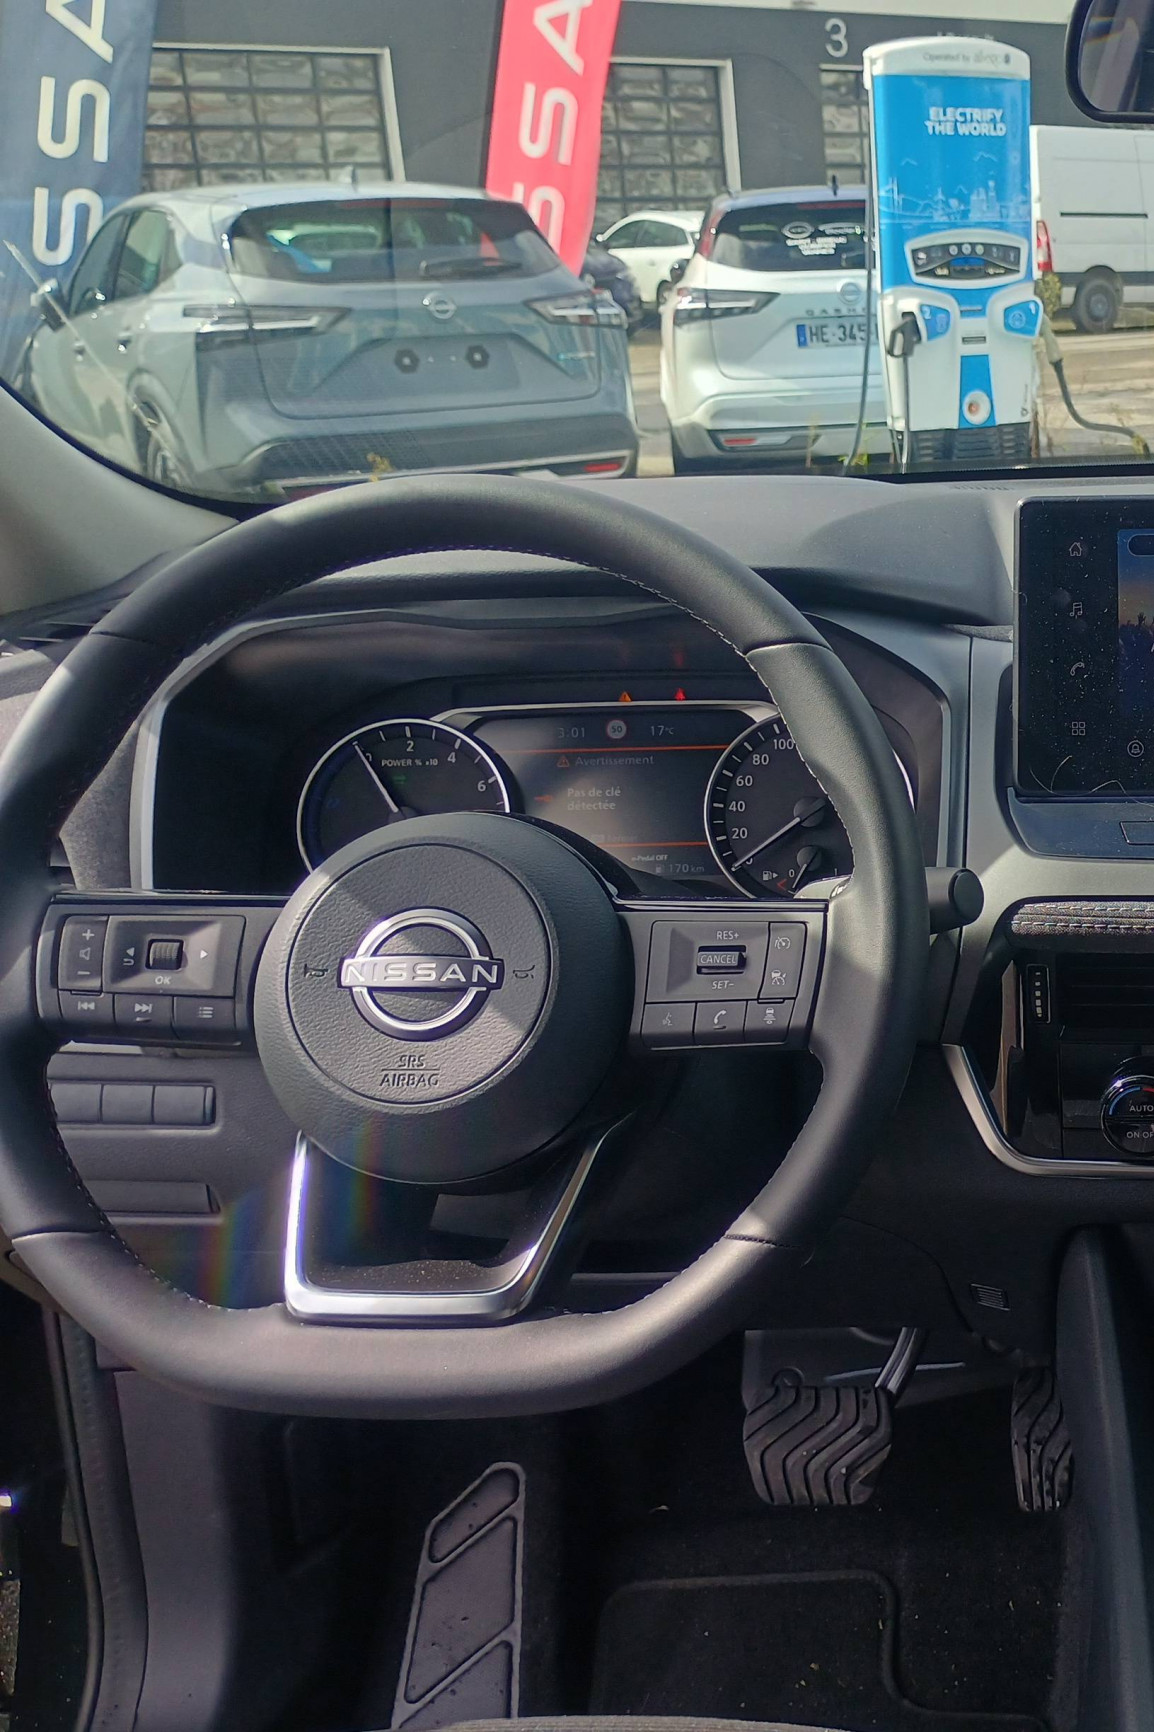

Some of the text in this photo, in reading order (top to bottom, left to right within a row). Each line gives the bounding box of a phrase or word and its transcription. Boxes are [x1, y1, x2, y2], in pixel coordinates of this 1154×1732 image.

[824, 18, 849, 58] 3
[929, 107, 1004, 122] ELECTRIFY
[924, 120, 1007, 137] THE WORLD
[557, 727, 586, 739] 3:01
[611, 725, 623, 733] 50
[406, 740, 414, 752] 2
[773, 738, 795, 750] 100
[381, 759, 413, 767] POWER
[447, 752, 457, 763] 4
[575, 755, 654, 766] Avertissement
[752, 754, 770, 765] 80
[477, 780, 486, 792] 6
[736, 775, 753, 786] 60
[567, 785, 621, 798] Pas de clé
[567, 798, 617, 811] détectée
[728, 801, 746, 812] 40
[731, 828, 748, 839] 20
[668, 864, 705, 873] 170 km
[788, 868, 795, 878] 0
[716, 931, 740, 941] RES+
[700, 954, 737, 964] CANCEL
[344, 963, 498, 984] NISSAN
[155, 975, 171, 985] OK
[712, 981, 735, 990] SET-
[398, 1054, 425, 1068] SRS
[380, 1073, 439, 1087] AIRBAG
[1126, 1131, 1140, 1139] ON
